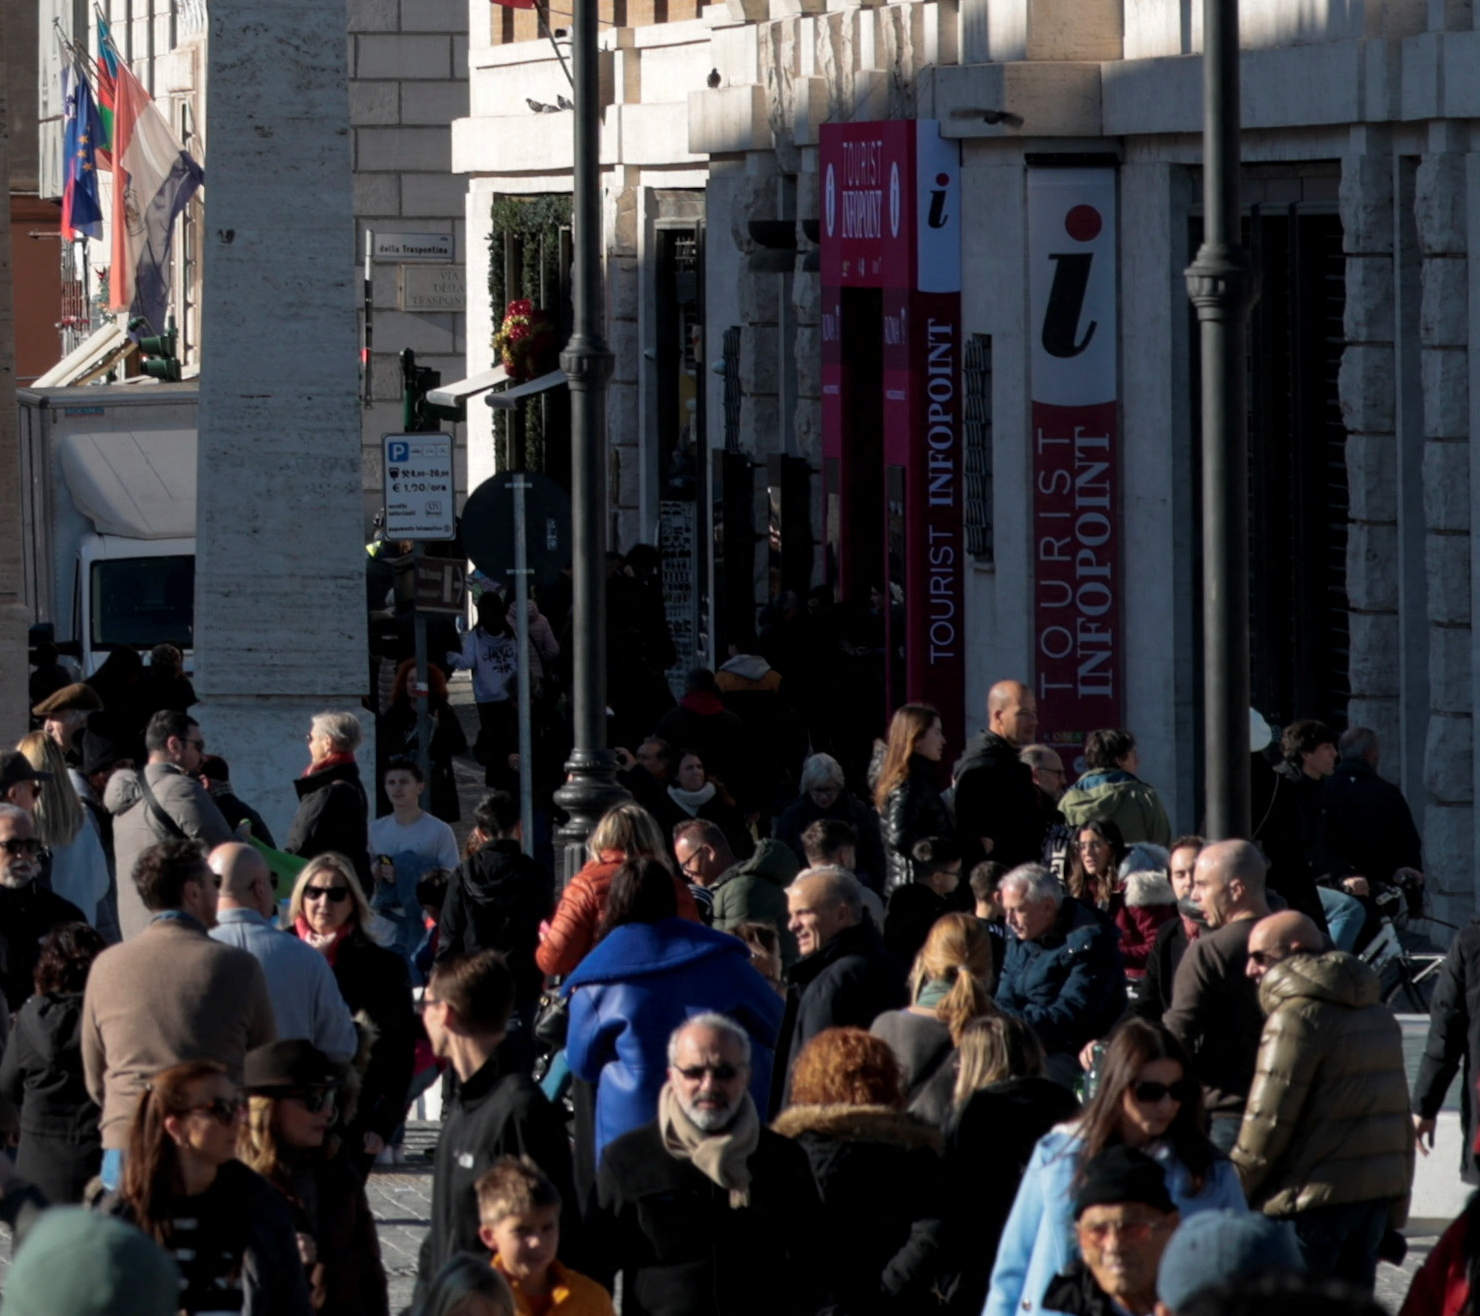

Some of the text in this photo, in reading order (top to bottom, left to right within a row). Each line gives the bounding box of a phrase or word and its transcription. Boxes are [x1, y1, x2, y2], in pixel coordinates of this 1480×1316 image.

[842, 139, 883, 187] TOURIST
[841, 189, 883, 239] INFOPOINT
[380, 244, 448, 255] della Traspontina
[392, 444, 405, 460] P
[927, 317, 956, 666] TOURIST INFOPOINT
[1037, 427, 1075, 700] TOURIST
[1074, 425, 1114, 700] INFOPOINT
